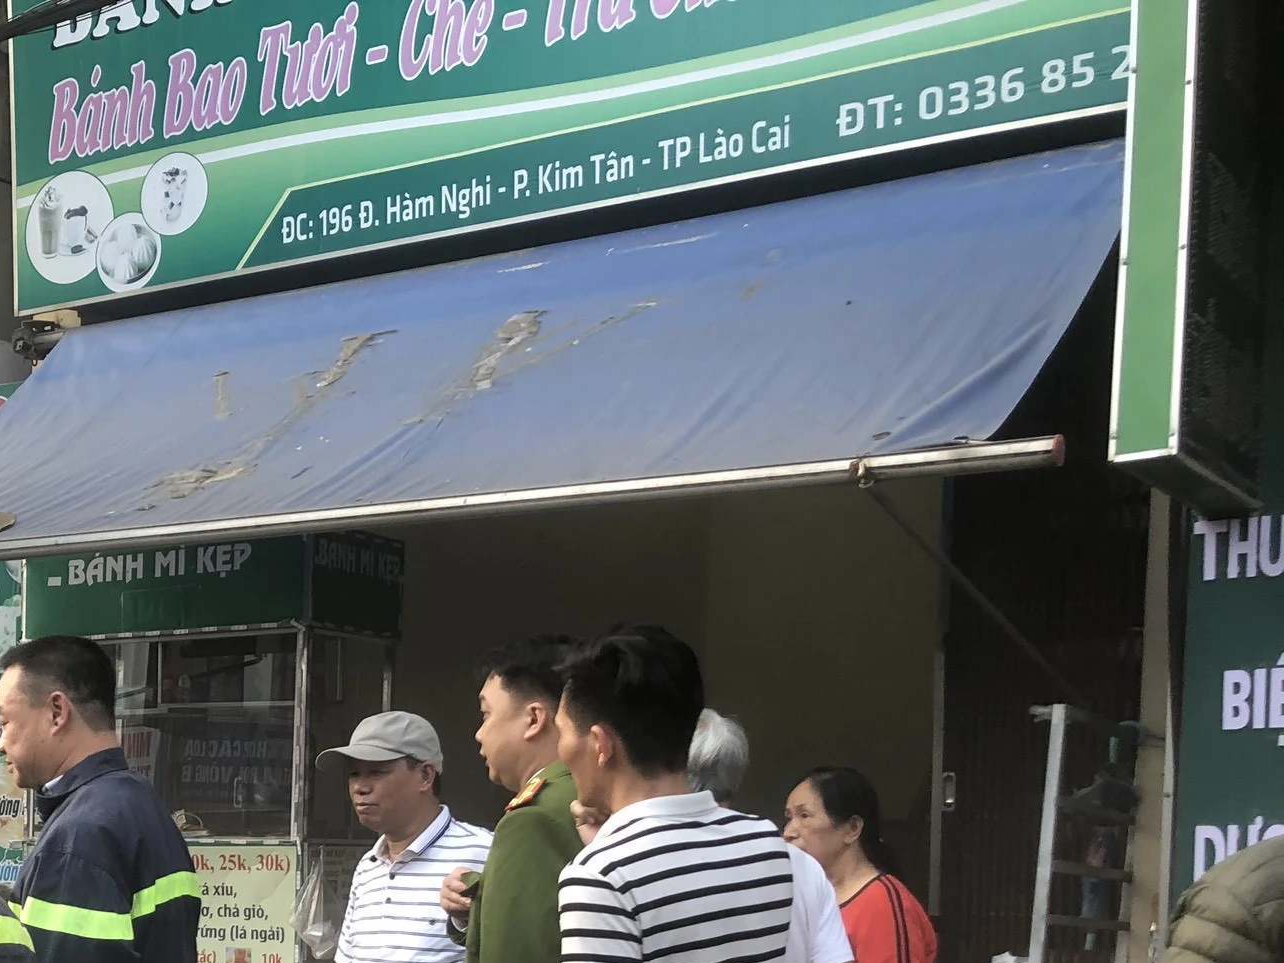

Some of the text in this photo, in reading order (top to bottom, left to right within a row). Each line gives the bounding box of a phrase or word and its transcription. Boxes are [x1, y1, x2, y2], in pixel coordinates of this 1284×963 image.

[47, 60, 156, 165] Bánh
[163, 48, 247, 138] Bao
[257, 2, 359, 116] Tươi
[281, 216, 314, 244] ĐC:
[318, 208, 353, 236] 196
[357, 203, 380, 230] Đ.
[385, 189, 435, 225] Hàm
[440, 175, 492, 219] Nghi
[513, 169, 530, 199] P.
[538, 161, 583, 193] Kim
[589, 151, 635, 185] Tân
[658, 136, 691, 171] TP
[699, 127, 743, 165] Lào
[751, 115, 791, 153] Cai
[836, 94, 903, 137] ĐT:
[918, 67, 1025, 121] 0336
[1040, 51, 1095, 95] 85
[67, 552, 144, 587] BÁNH
[154, 545, 186, 579] MÌ
[196, 542, 253, 578] KẸP
[192, 853, 291, 875] 0k, 25k, 30k)
[212, 882, 238, 898] xíu,
[217, 903, 240, 919] chả
[243, 903, 269, 921] giò,
[230, 925, 247, 942] (lá
[250, 925, 285, 944] ngải)
